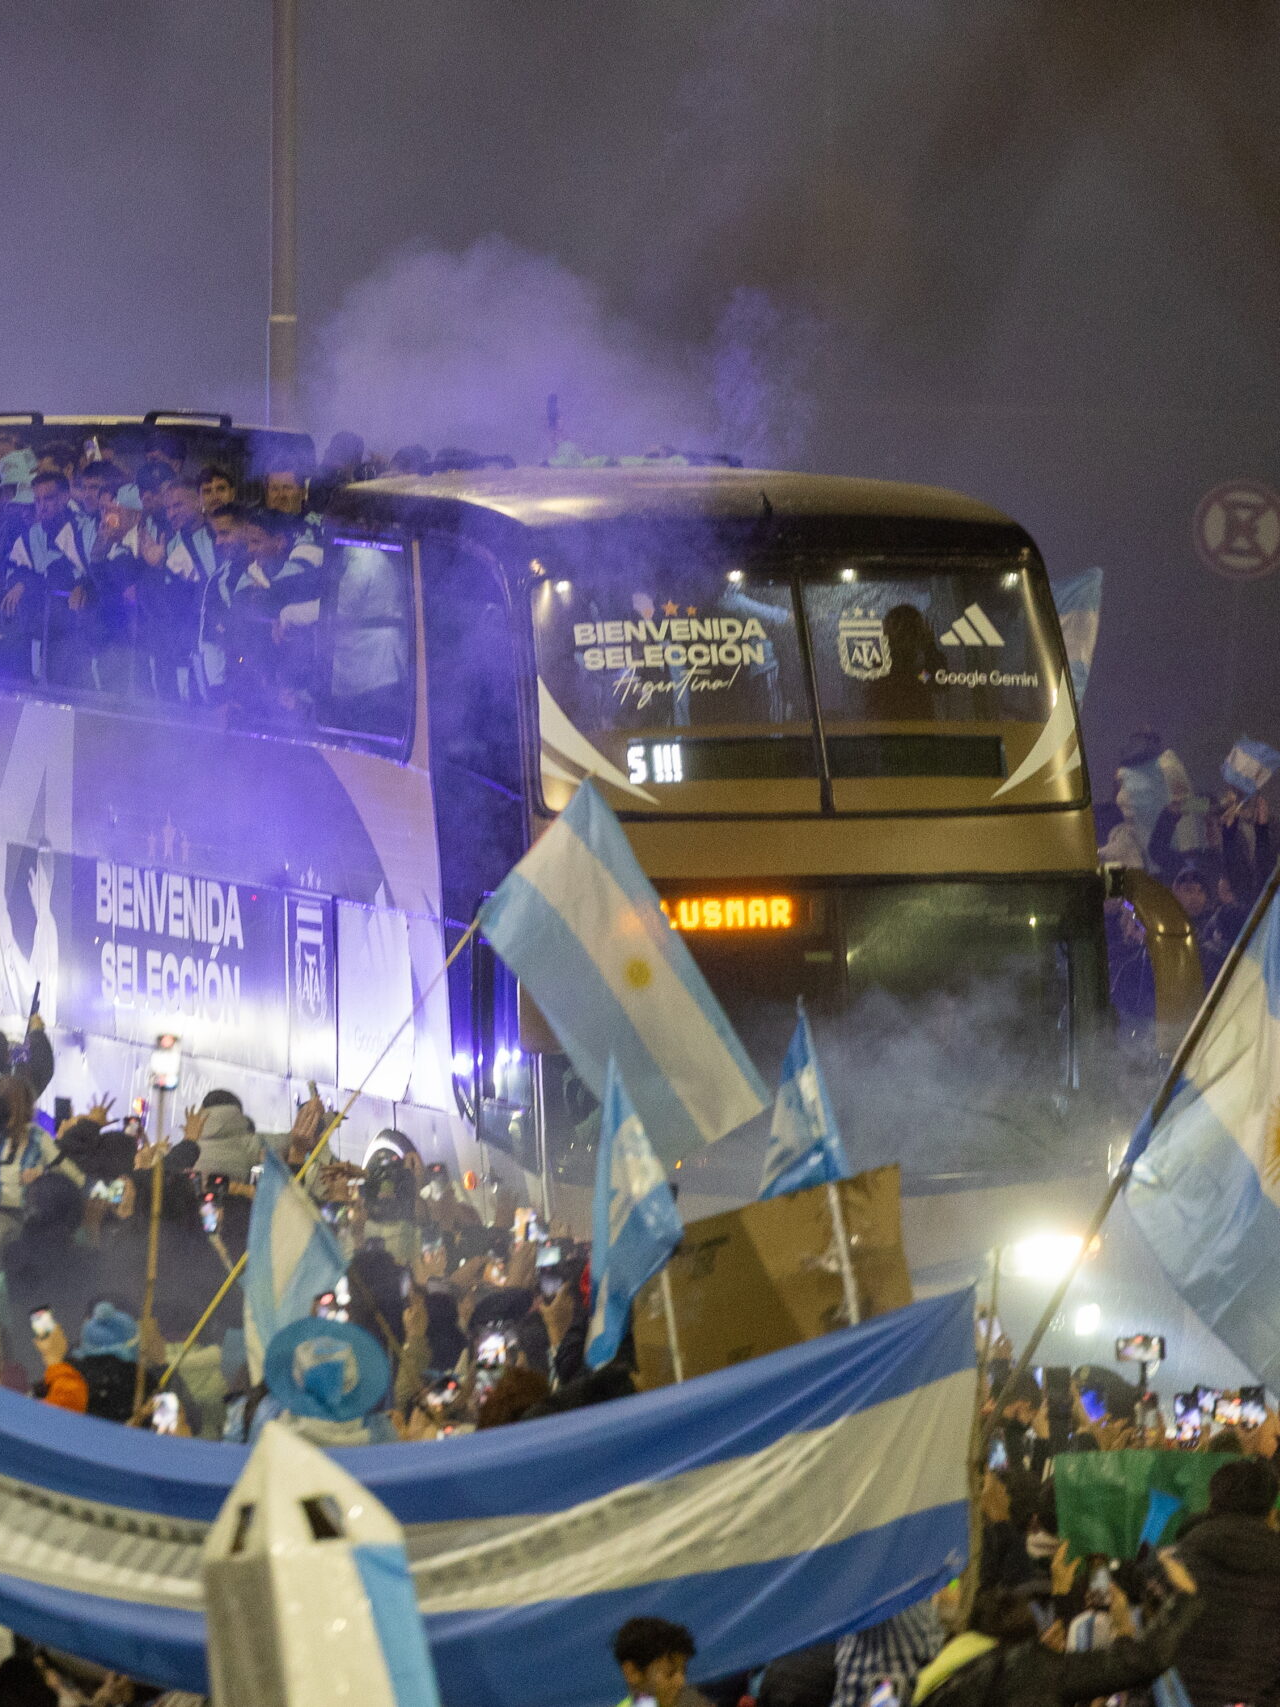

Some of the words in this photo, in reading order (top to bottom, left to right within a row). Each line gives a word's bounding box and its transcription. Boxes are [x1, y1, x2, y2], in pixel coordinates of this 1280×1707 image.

[574, 617, 768, 647] BIENVENIDA
[583, 637, 765, 671] SELECCIÓN
[934, 669, 988, 688] Google
[989, 669, 1039, 688] Gemini
[96, 862, 244, 950] BIENVENIDA
[101, 941, 241, 1026] SELECCIÓN
